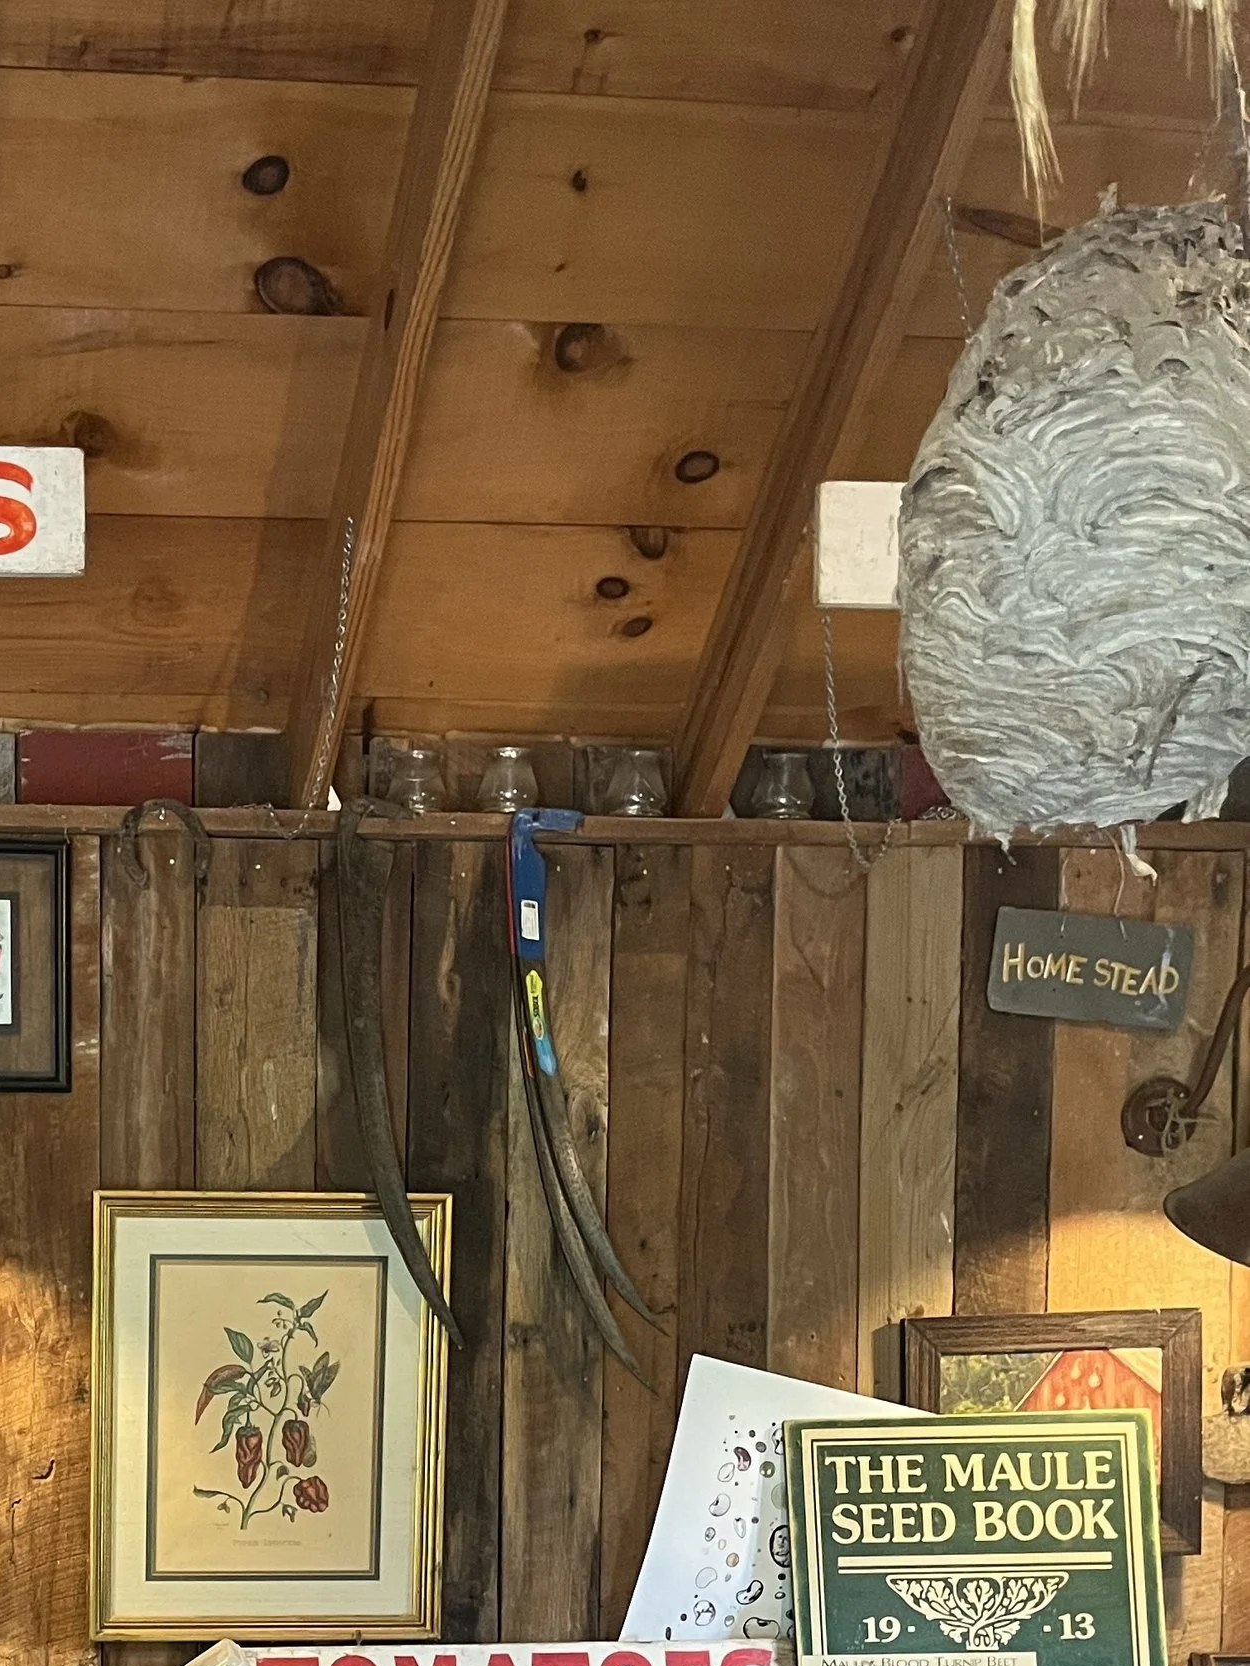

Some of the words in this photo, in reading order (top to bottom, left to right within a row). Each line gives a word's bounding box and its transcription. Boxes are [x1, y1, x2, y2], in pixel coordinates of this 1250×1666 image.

[824, 1455, 927, 1494] THE
[942, 1451, 1116, 1492] MAULE
[831, 1503, 957, 1544] SEED
[972, 1499, 1118, 1542] BOOK
[862, 1616, 901, 1643] 19
[1058, 1612, 1096, 1640] 13
